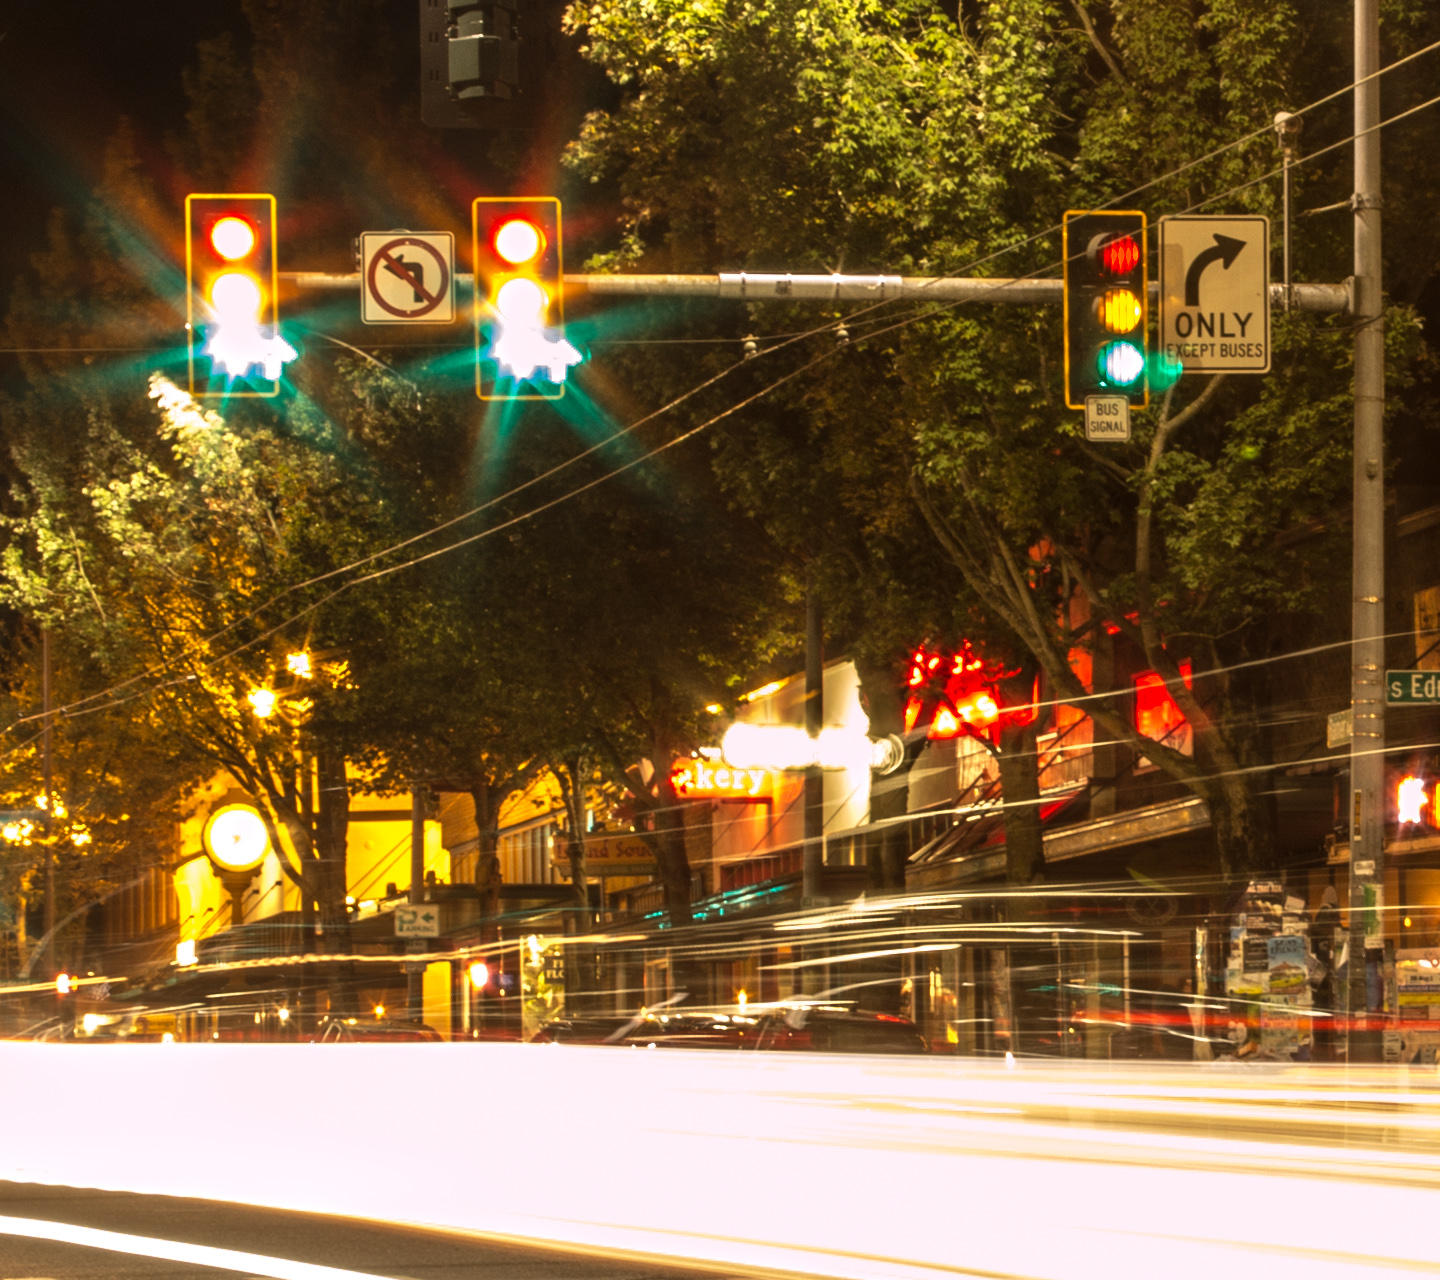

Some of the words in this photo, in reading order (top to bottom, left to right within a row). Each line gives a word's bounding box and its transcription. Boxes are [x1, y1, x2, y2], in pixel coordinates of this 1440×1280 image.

[1175, 312, 1253, 339] ONLY
[1166, 343, 1216, 358] EXCEPT
[1220, 343, 1263, 358] BUSES
[1096, 403, 1119, 416] BUS
[1090, 420, 1126, 434] SIGNAL
[615, 841, 653, 858] Sou
